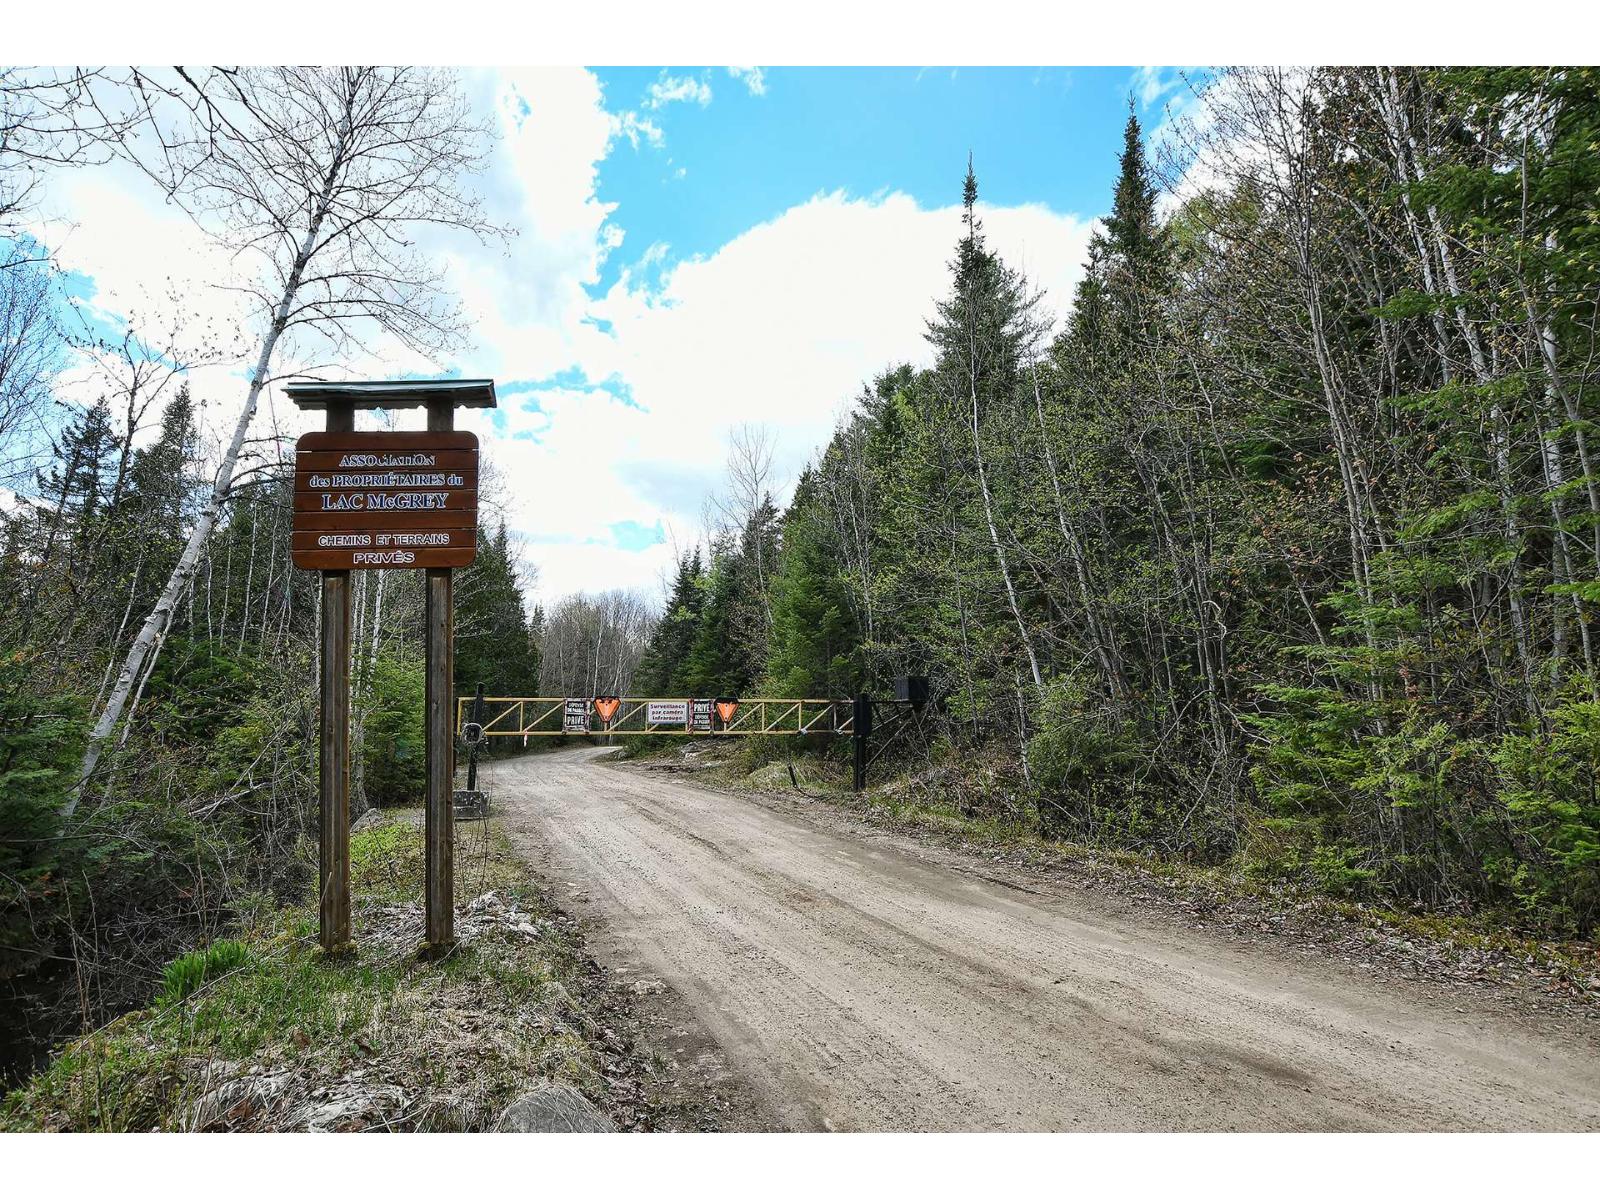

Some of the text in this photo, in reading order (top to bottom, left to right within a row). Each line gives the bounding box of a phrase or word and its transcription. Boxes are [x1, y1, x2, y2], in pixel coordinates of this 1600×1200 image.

[310, 472, 464, 487] des PROPRIÉTAIRES du
[322, 493, 449, 510] LAC McGREY
[318, 534, 450, 547] CHEMINS ET TERRAINS
[353, 550, 416, 564] PRIVÉS
